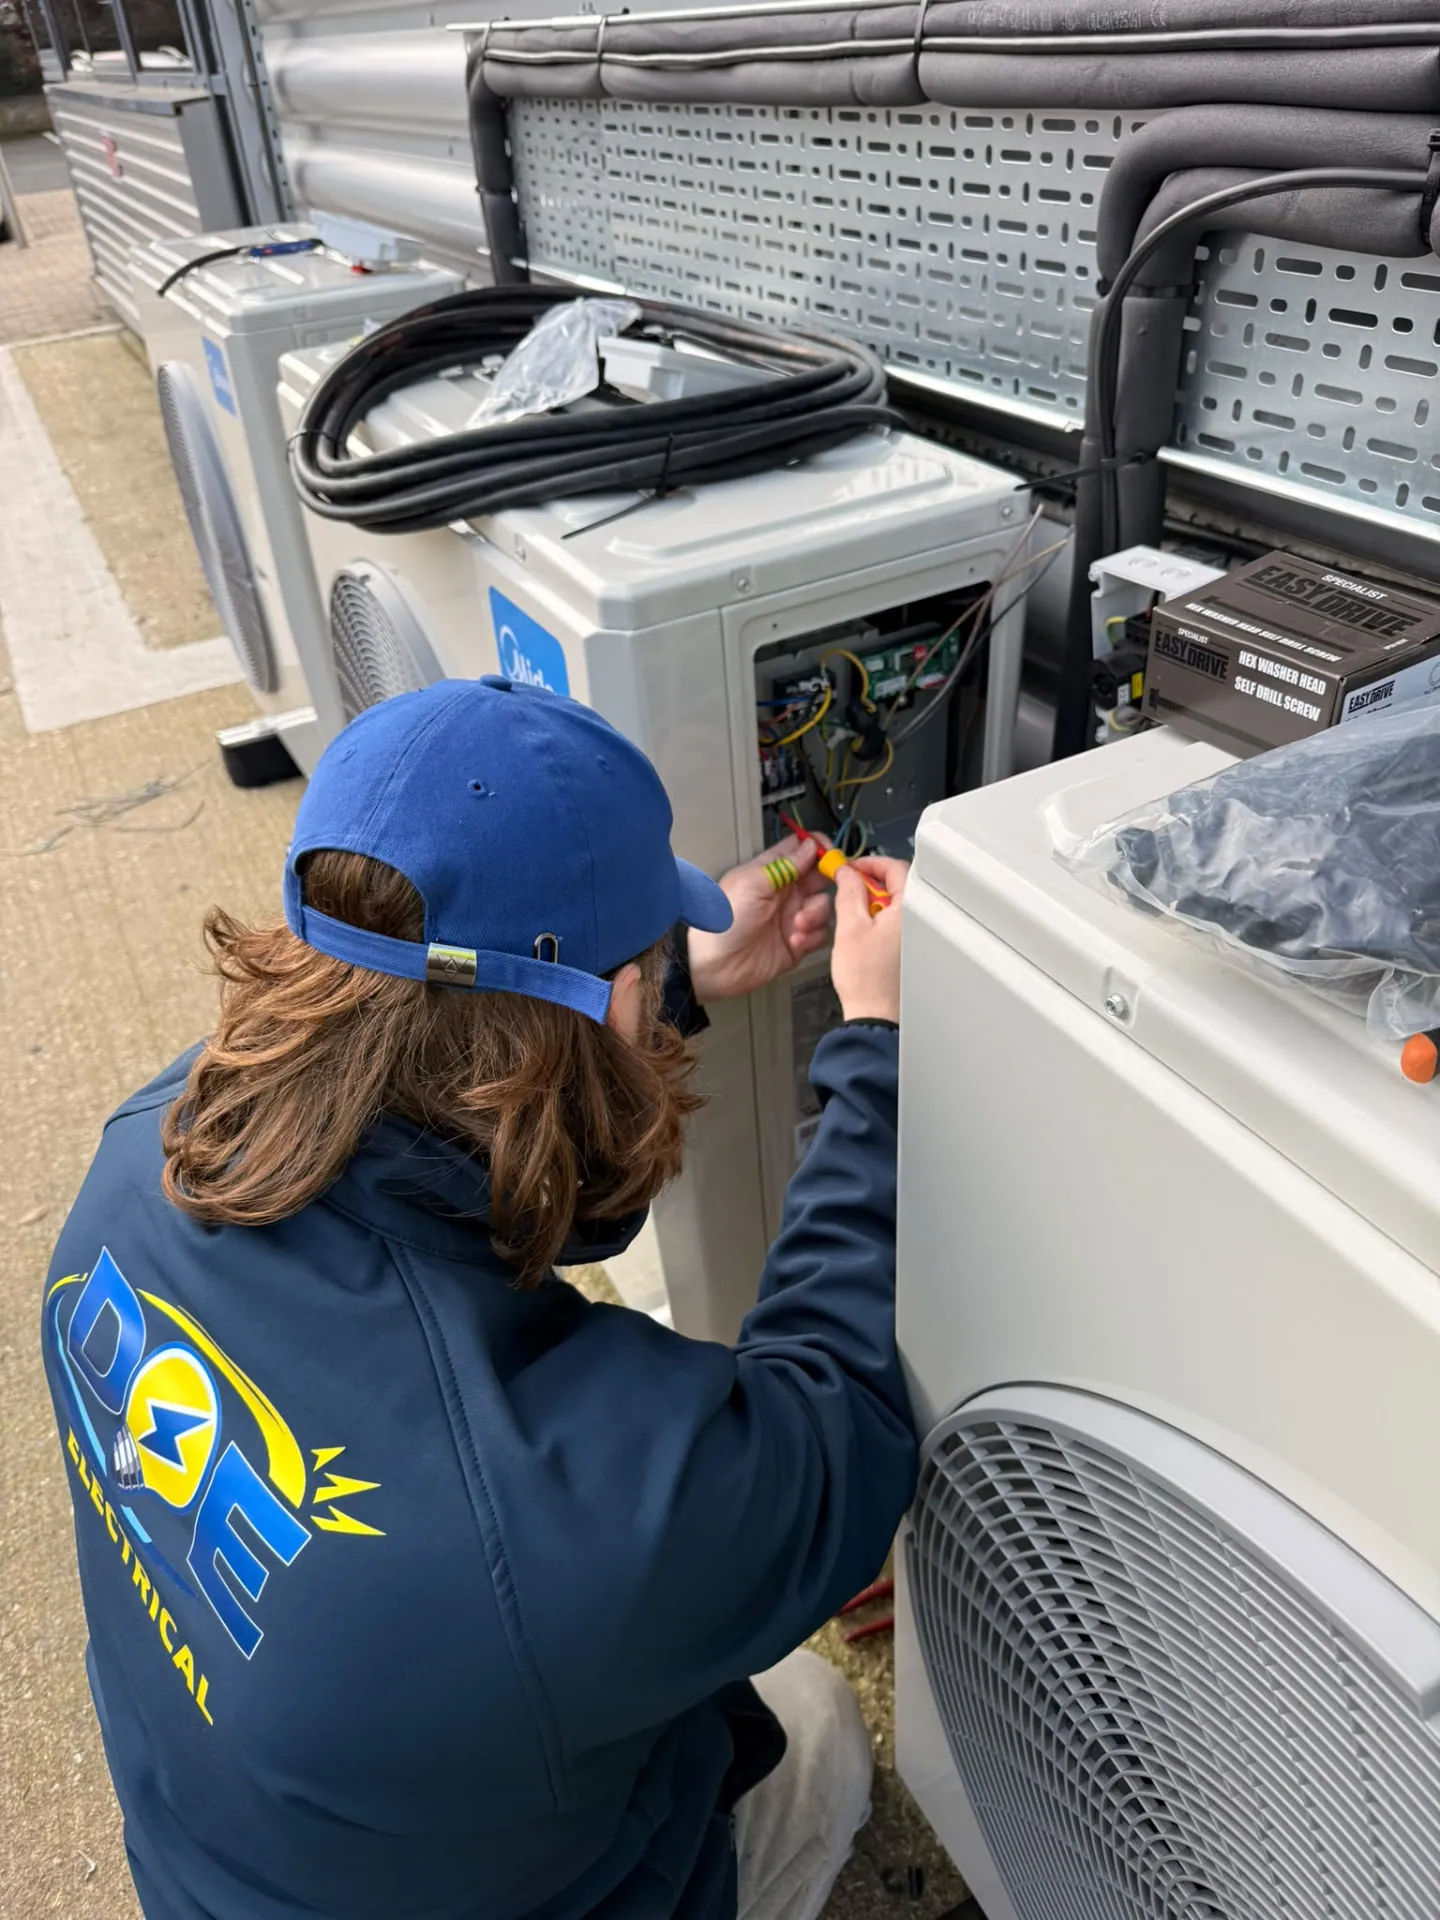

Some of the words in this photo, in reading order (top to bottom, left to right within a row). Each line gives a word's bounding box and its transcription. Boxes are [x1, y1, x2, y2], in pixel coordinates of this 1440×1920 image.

[1321, 574, 1388, 600] SPECIALIST
[1178, 627, 1209, 645] SPECIALIST
[1185, 602, 1206, 613] HEX
[1201, 608, 1240, 626] WASHER
[1235, 621, 1263, 634] HEAD
[1258, 630, 1283, 641] SELF
[1278, 637, 1307, 650] DRILL
[1303, 646, 1343, 662] SCREW
[1238, 650, 1258, 669] HEX
[1258, 657, 1300, 685] WASHER
[1298, 673, 1327, 695] HEAD
[1234, 675, 1257, 695] SELF
[1256, 684, 1283, 707] DRILL
[1283, 695, 1321, 721] SCREW
[66, 1424, 214, 1726] ELECTRICAL
